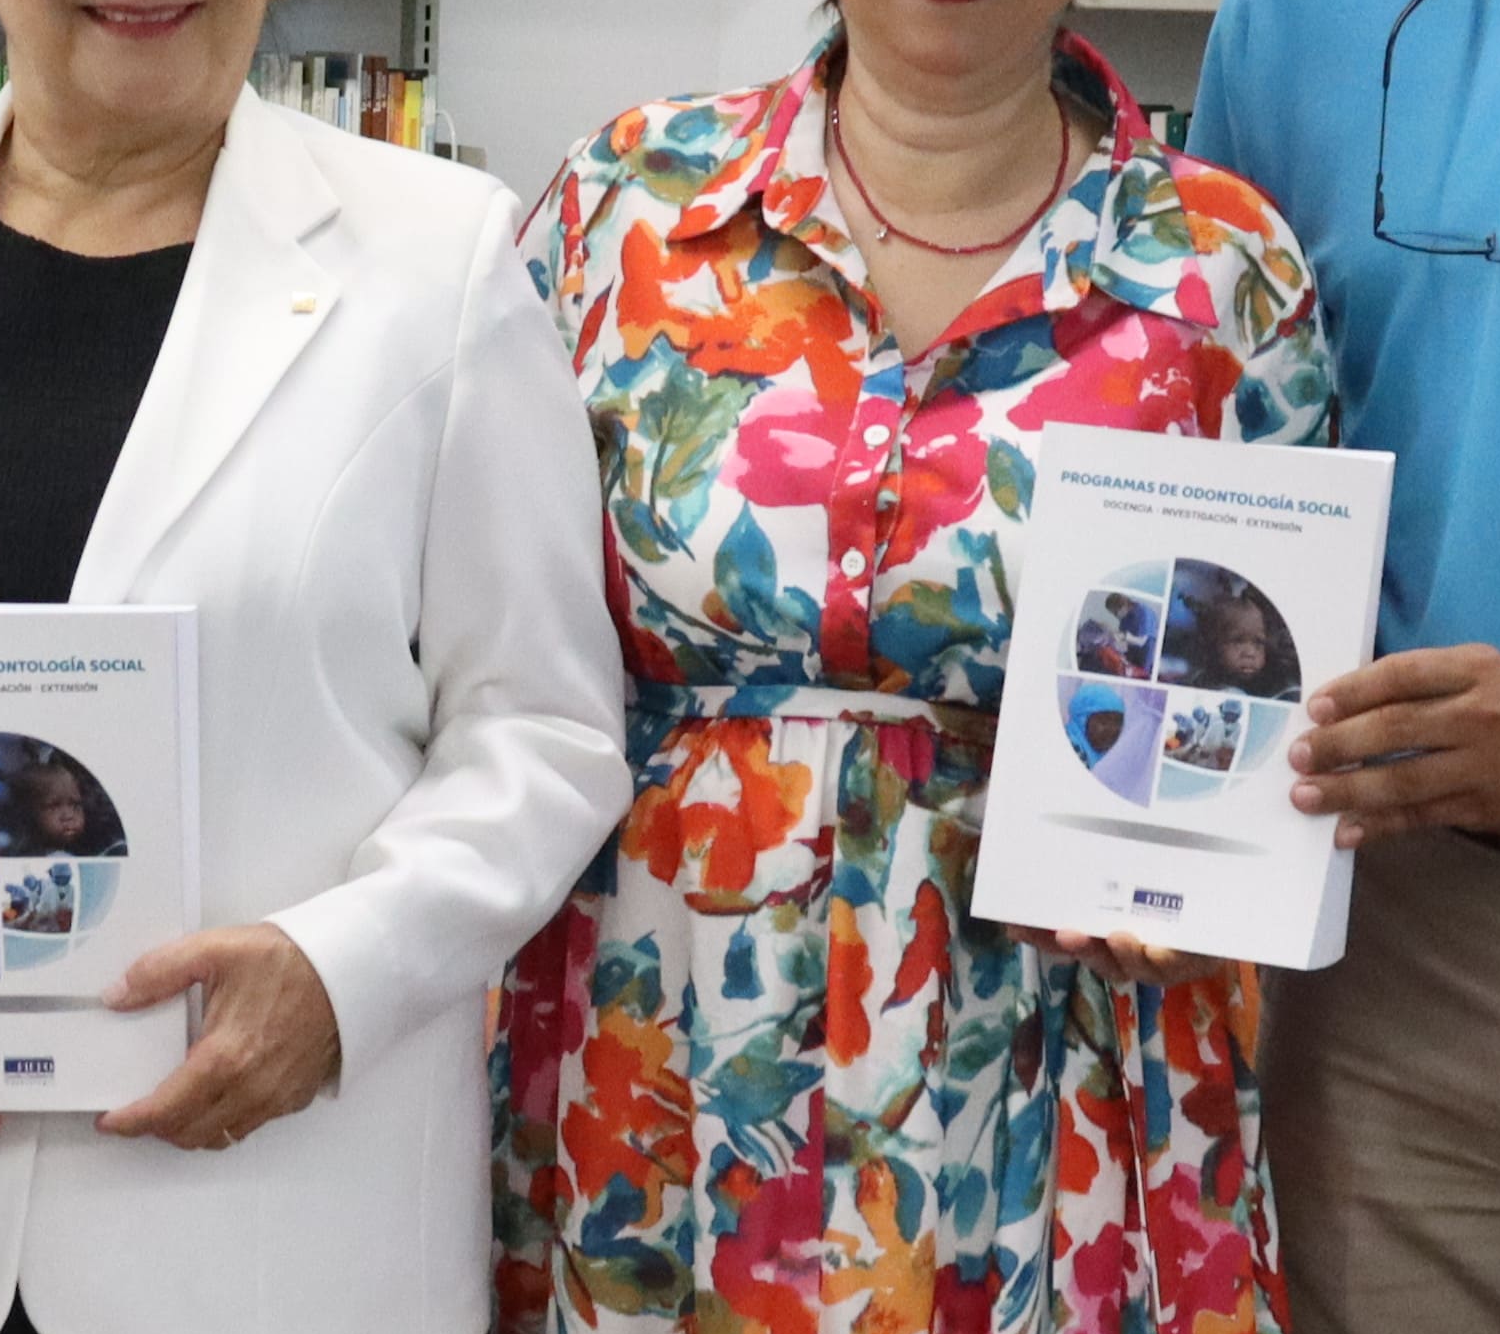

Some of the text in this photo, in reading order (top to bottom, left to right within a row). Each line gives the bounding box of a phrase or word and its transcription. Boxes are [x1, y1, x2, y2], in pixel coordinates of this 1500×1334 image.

[1060, 470, 1353, 519] PROGRAMAS DE ODONTOLOGÍA SOCIAL
[1103, 499, 1304, 534] DOCENCIA INVESTIGACIÓN EXTENSIÓN
[89, 659, 146, 673] SOCIAL
[40, 681, 98, 693] EXTENSIÓN
